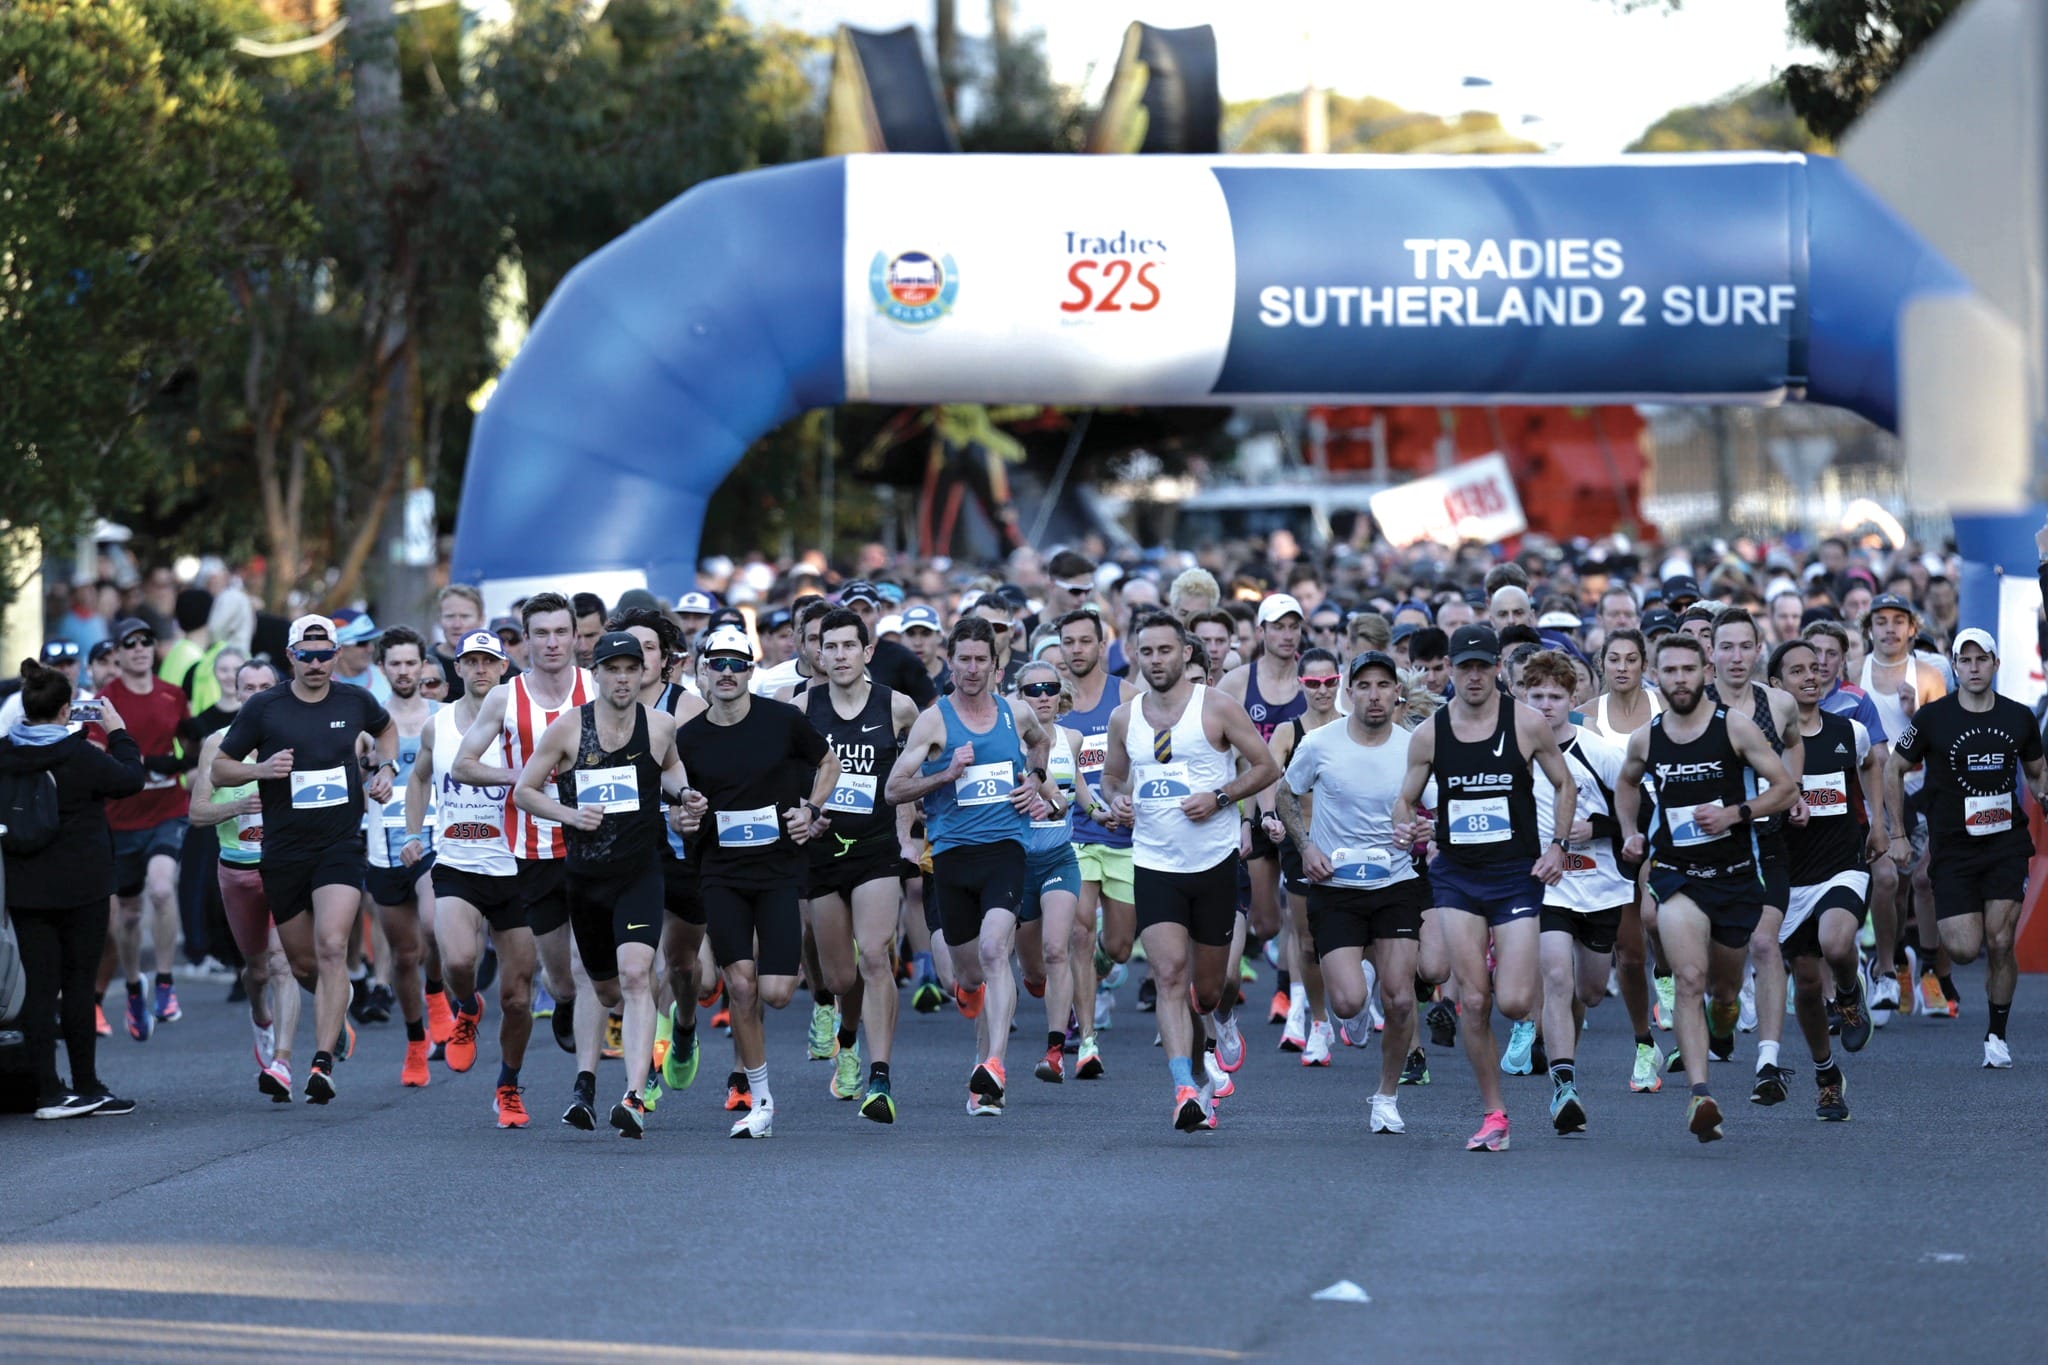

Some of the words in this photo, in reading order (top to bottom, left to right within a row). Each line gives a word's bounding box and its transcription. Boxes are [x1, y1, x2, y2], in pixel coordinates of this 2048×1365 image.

[1403, 238, 1624, 280] TRADIES
[1059, 258, 1162, 313] S2S
[1258, 284, 1603, 327] SUTHERLAND
[1618, 286, 1646, 326] 2
[1661, 284, 1797, 326] SURF
[837, 743, 875, 759] run
[1967, 753, 2005, 765] F45
[976, 779, 997, 797] 28
[1151, 780, 1170, 797] 26
[1447, 772, 1513, 789] pulse
[316, 785, 326, 801] 2
[599, 784, 616, 802] 21
[834, 788, 855, 805] 66
[1803, 788, 1837, 804] 2765
[453, 822, 490, 838] 3576
[1468, 815, 1490, 831] 88
[743, 825, 754, 840] 5
[1356, 864, 1367, 879] 4
